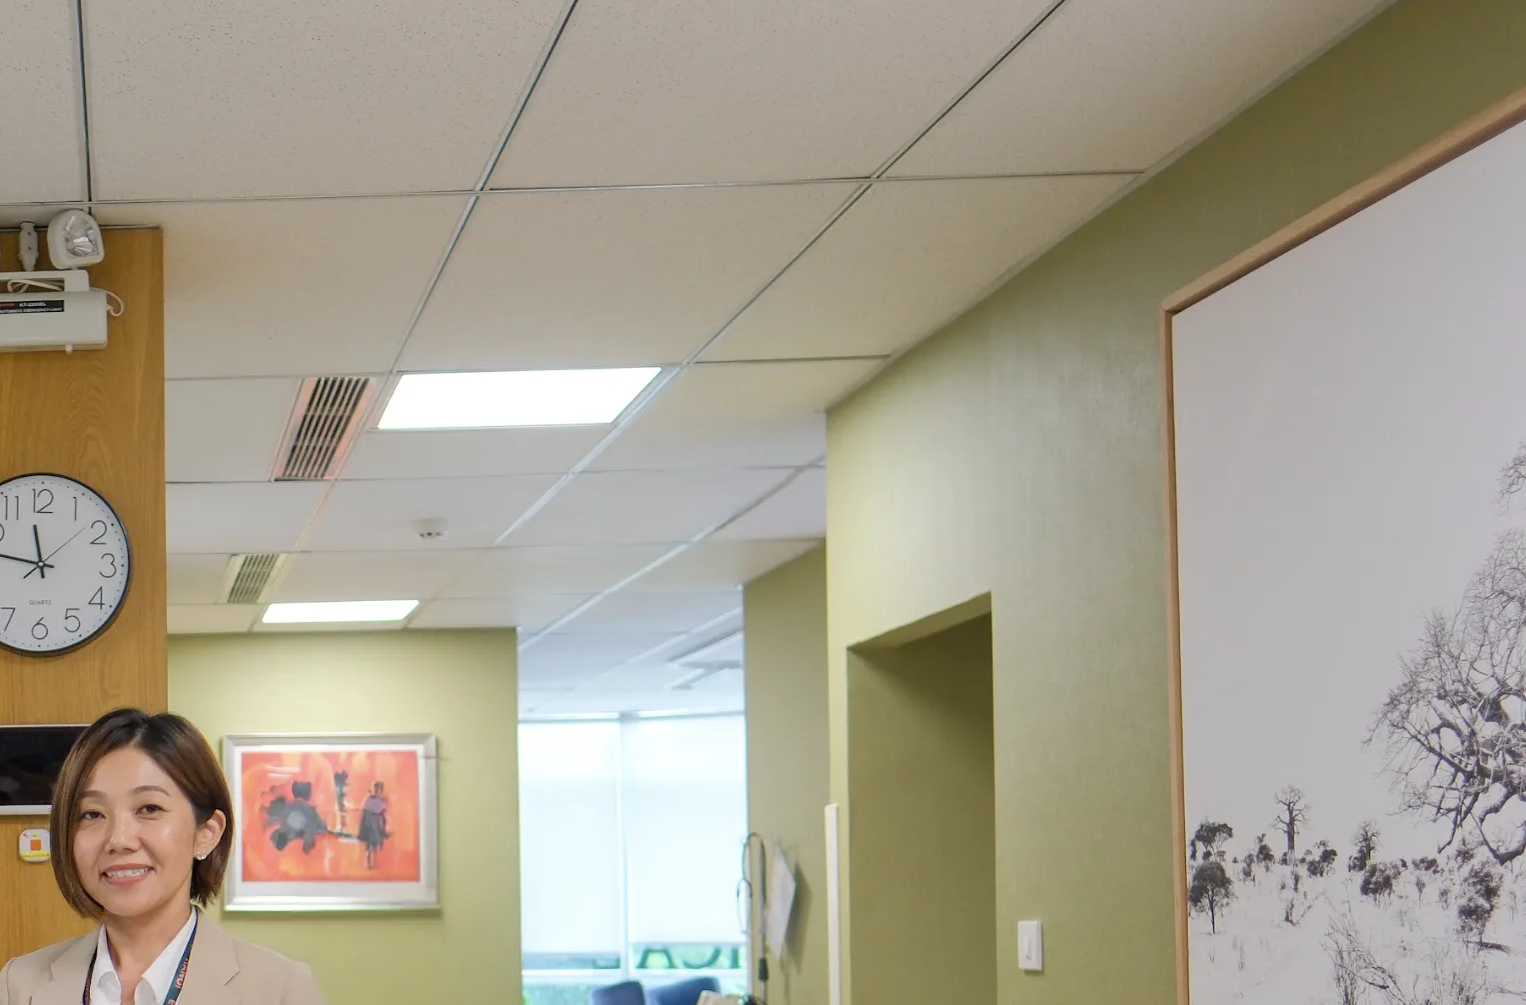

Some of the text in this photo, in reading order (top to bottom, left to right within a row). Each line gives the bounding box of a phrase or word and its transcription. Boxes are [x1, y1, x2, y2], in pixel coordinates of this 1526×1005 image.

[4, 495, 20, 521] 11
[31, 488, 54, 514] 12
[72, 496, 78, 521] 1
[90, 519, 108, 545] 2
[99, 552, 117, 579] 3
[88, 586, 105, 610] 4
[1, 606, 16, 632] 7
[31, 616, 49, 641] 6
[64, 607, 81, 633] 5
